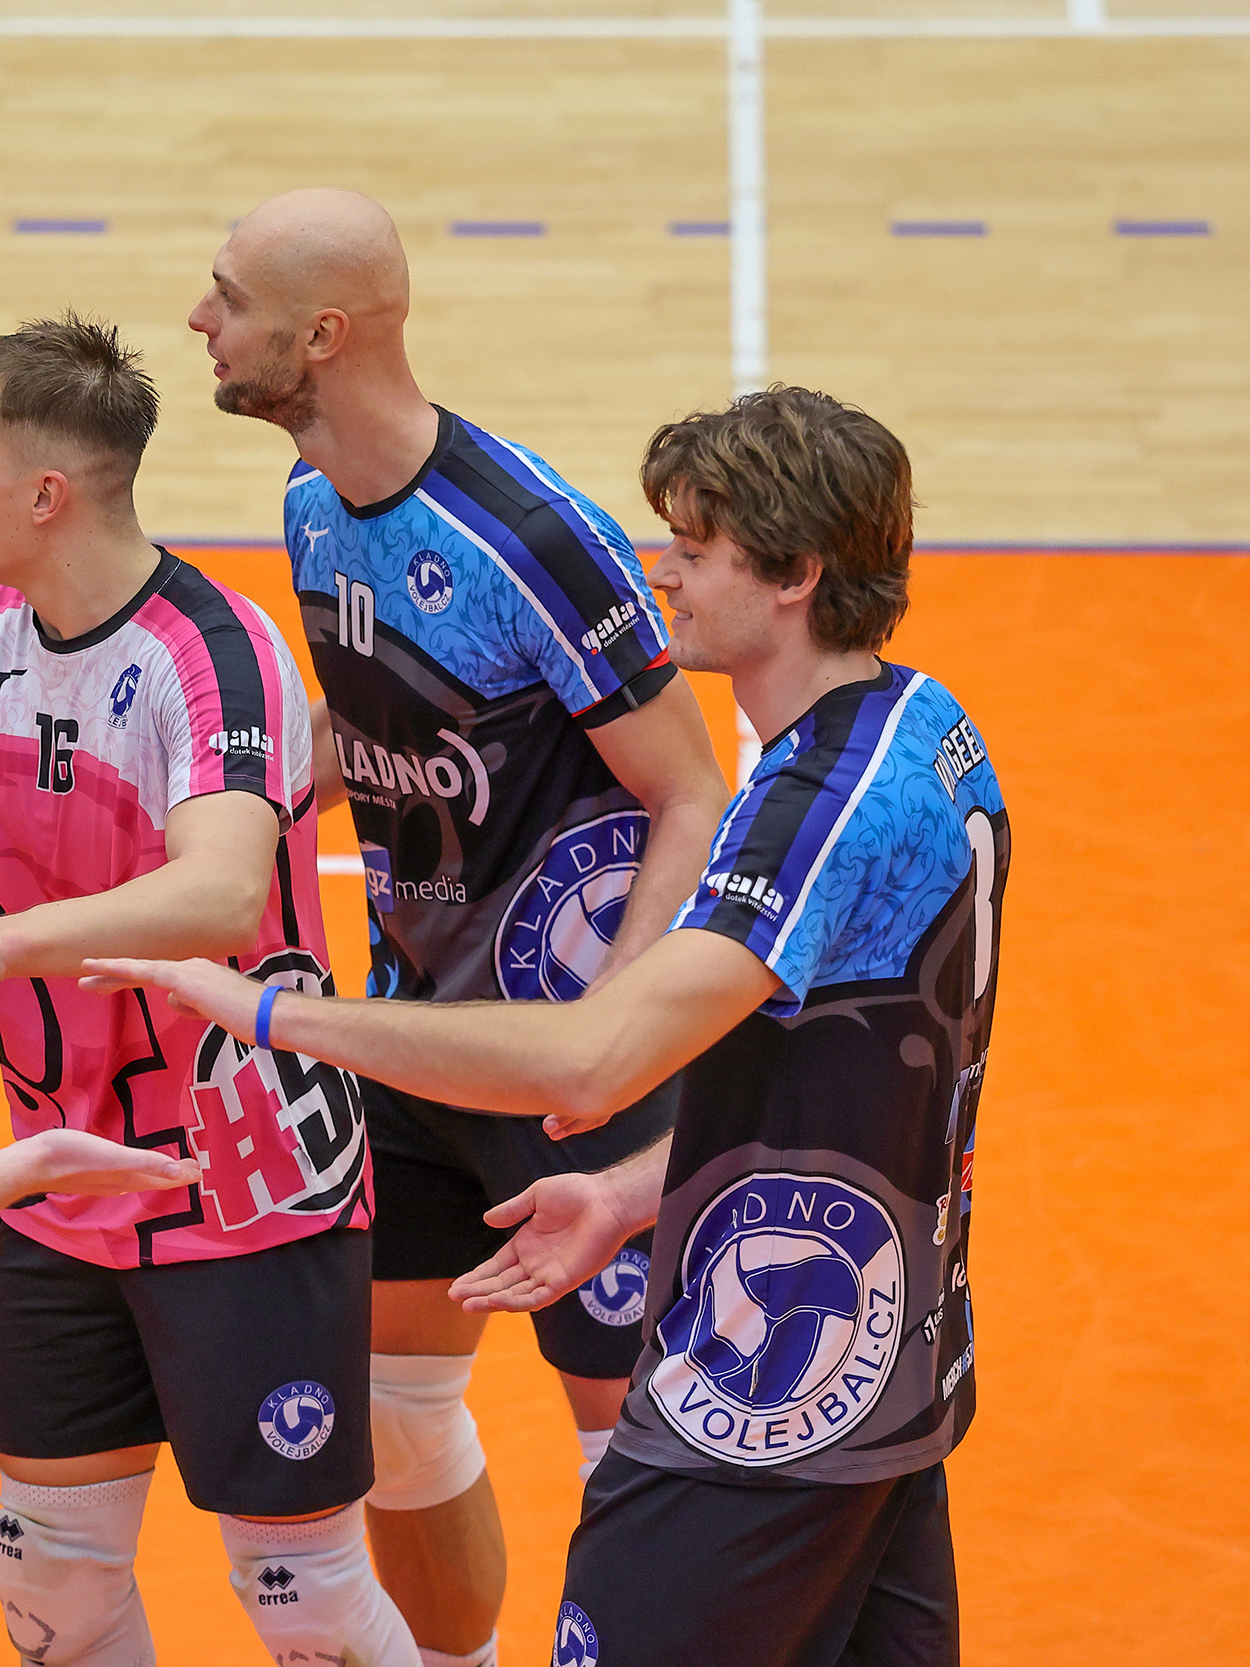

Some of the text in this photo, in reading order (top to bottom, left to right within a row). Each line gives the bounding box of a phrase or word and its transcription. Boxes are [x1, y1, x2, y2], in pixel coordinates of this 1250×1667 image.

[412, 552, 450, 577] KLADNO
[334, 571, 375, 657] 10
[581, 601, 637, 656] gala
[36, 712, 79, 794] 16
[208, 726, 274, 755] gala
[230, 747, 251, 755] dotek
[335, 733, 463, 798] LADNO
[366, 867, 467, 903] gz media
[510, 826, 639, 969] KLADN
[706, 872, 785, 914] gala
[725, 893, 747, 904] dotek
[620, 1251, 650, 1270] DNO
[267, 1384, 329, 1409] KLADNO
[258, 1588, 299, 1606] errea
